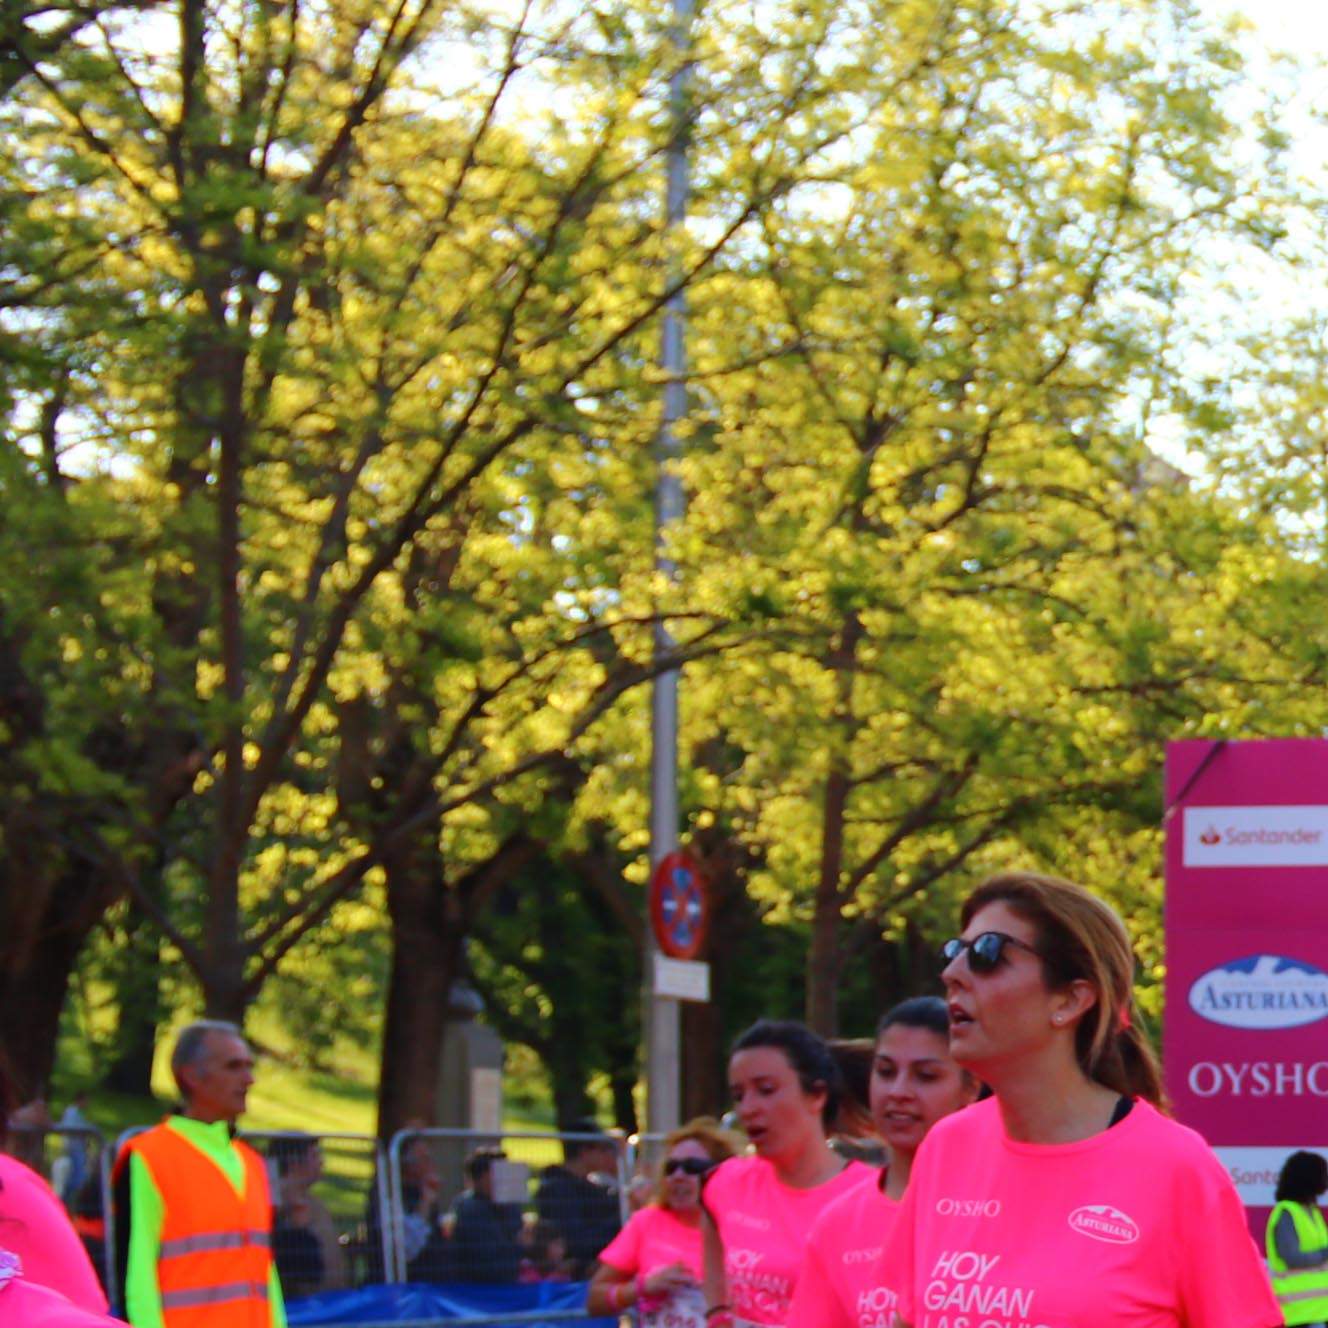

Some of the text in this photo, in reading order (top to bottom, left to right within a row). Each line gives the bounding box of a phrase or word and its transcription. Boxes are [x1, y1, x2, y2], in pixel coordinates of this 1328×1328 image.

[1225, 826, 1320, 846] Santander
[936, 1198, 1001, 1217] OYSHO
[1075, 1213, 1133, 1240] ASTURIANA
[932, 1252, 999, 1281] HOY
[924, 1283, 1034, 1318] GANAN
